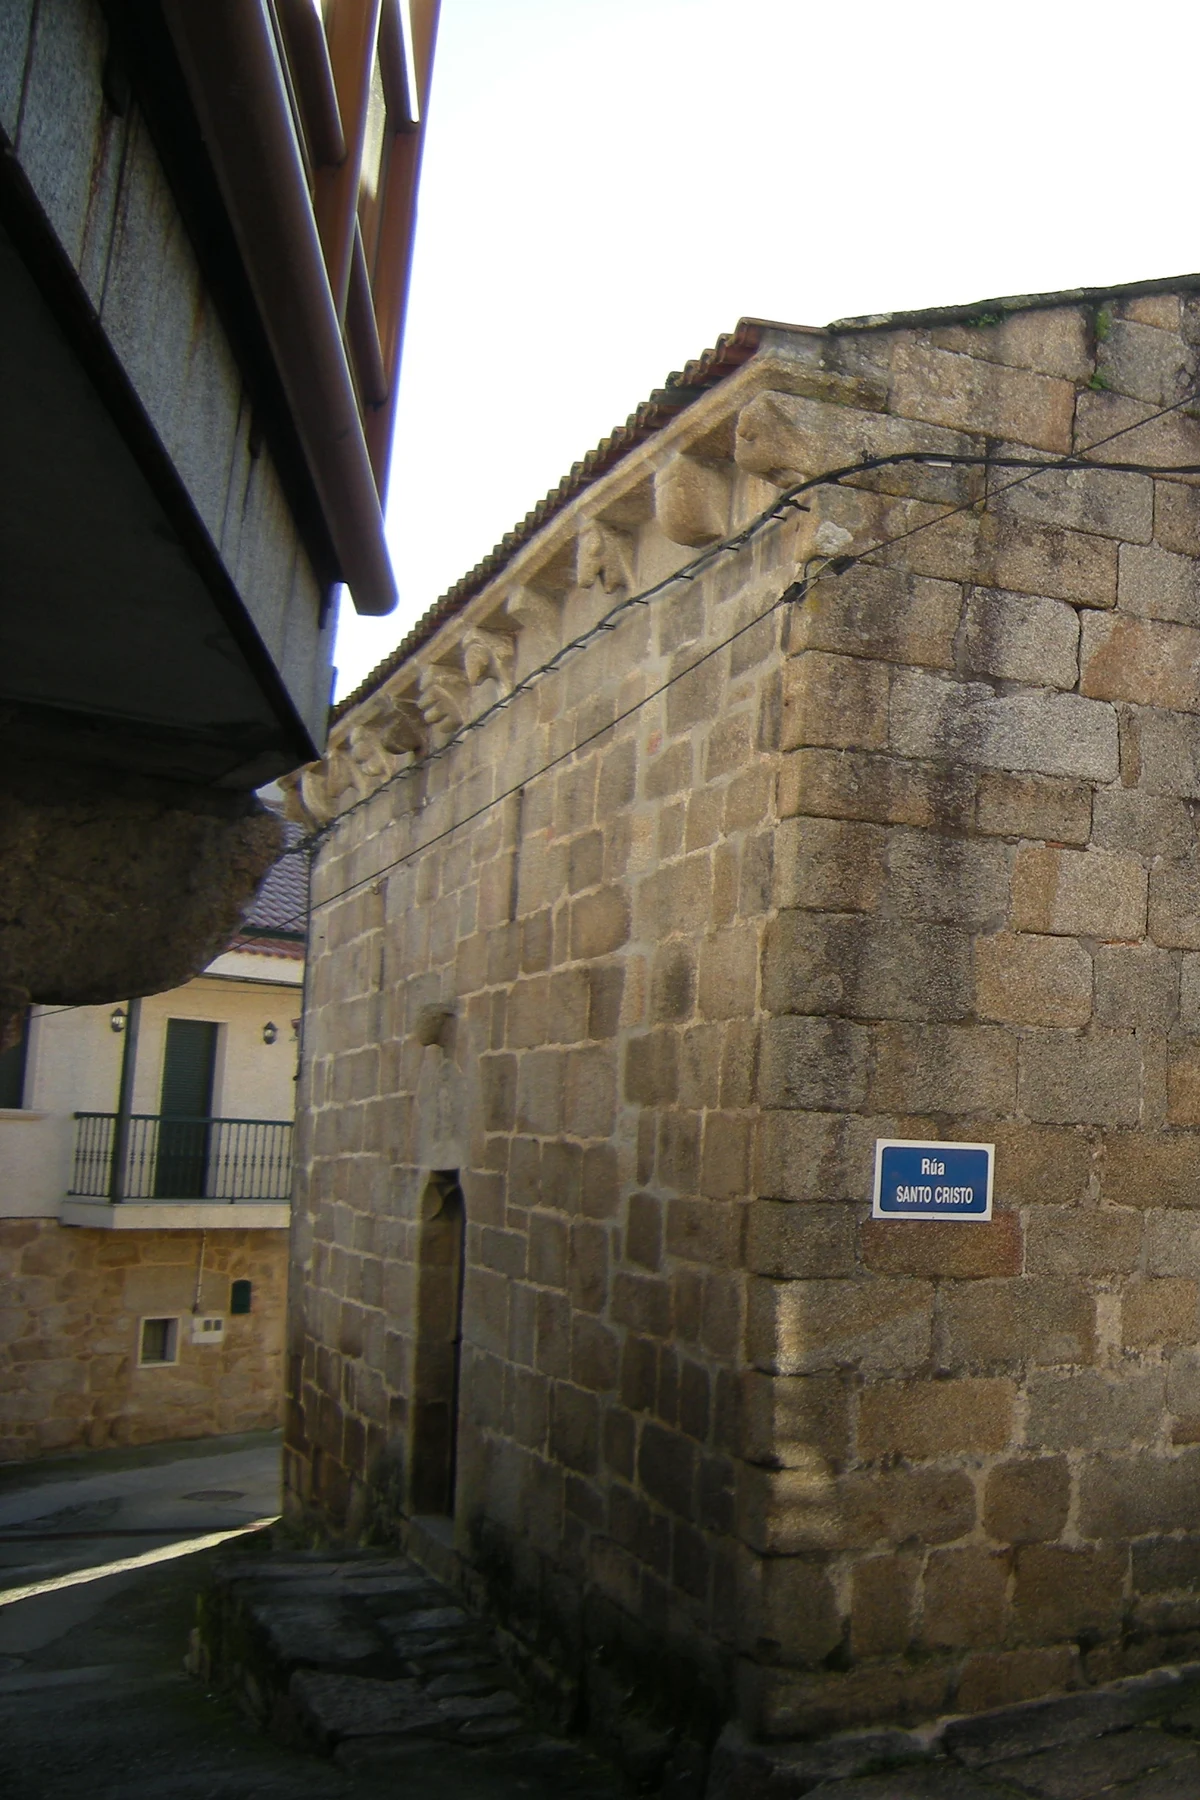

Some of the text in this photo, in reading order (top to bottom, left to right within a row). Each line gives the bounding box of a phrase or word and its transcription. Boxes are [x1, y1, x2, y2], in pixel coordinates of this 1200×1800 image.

[921, 1158, 945, 1175] Rúa
[896, 1185, 973, 1204] SANTO CRISTO
